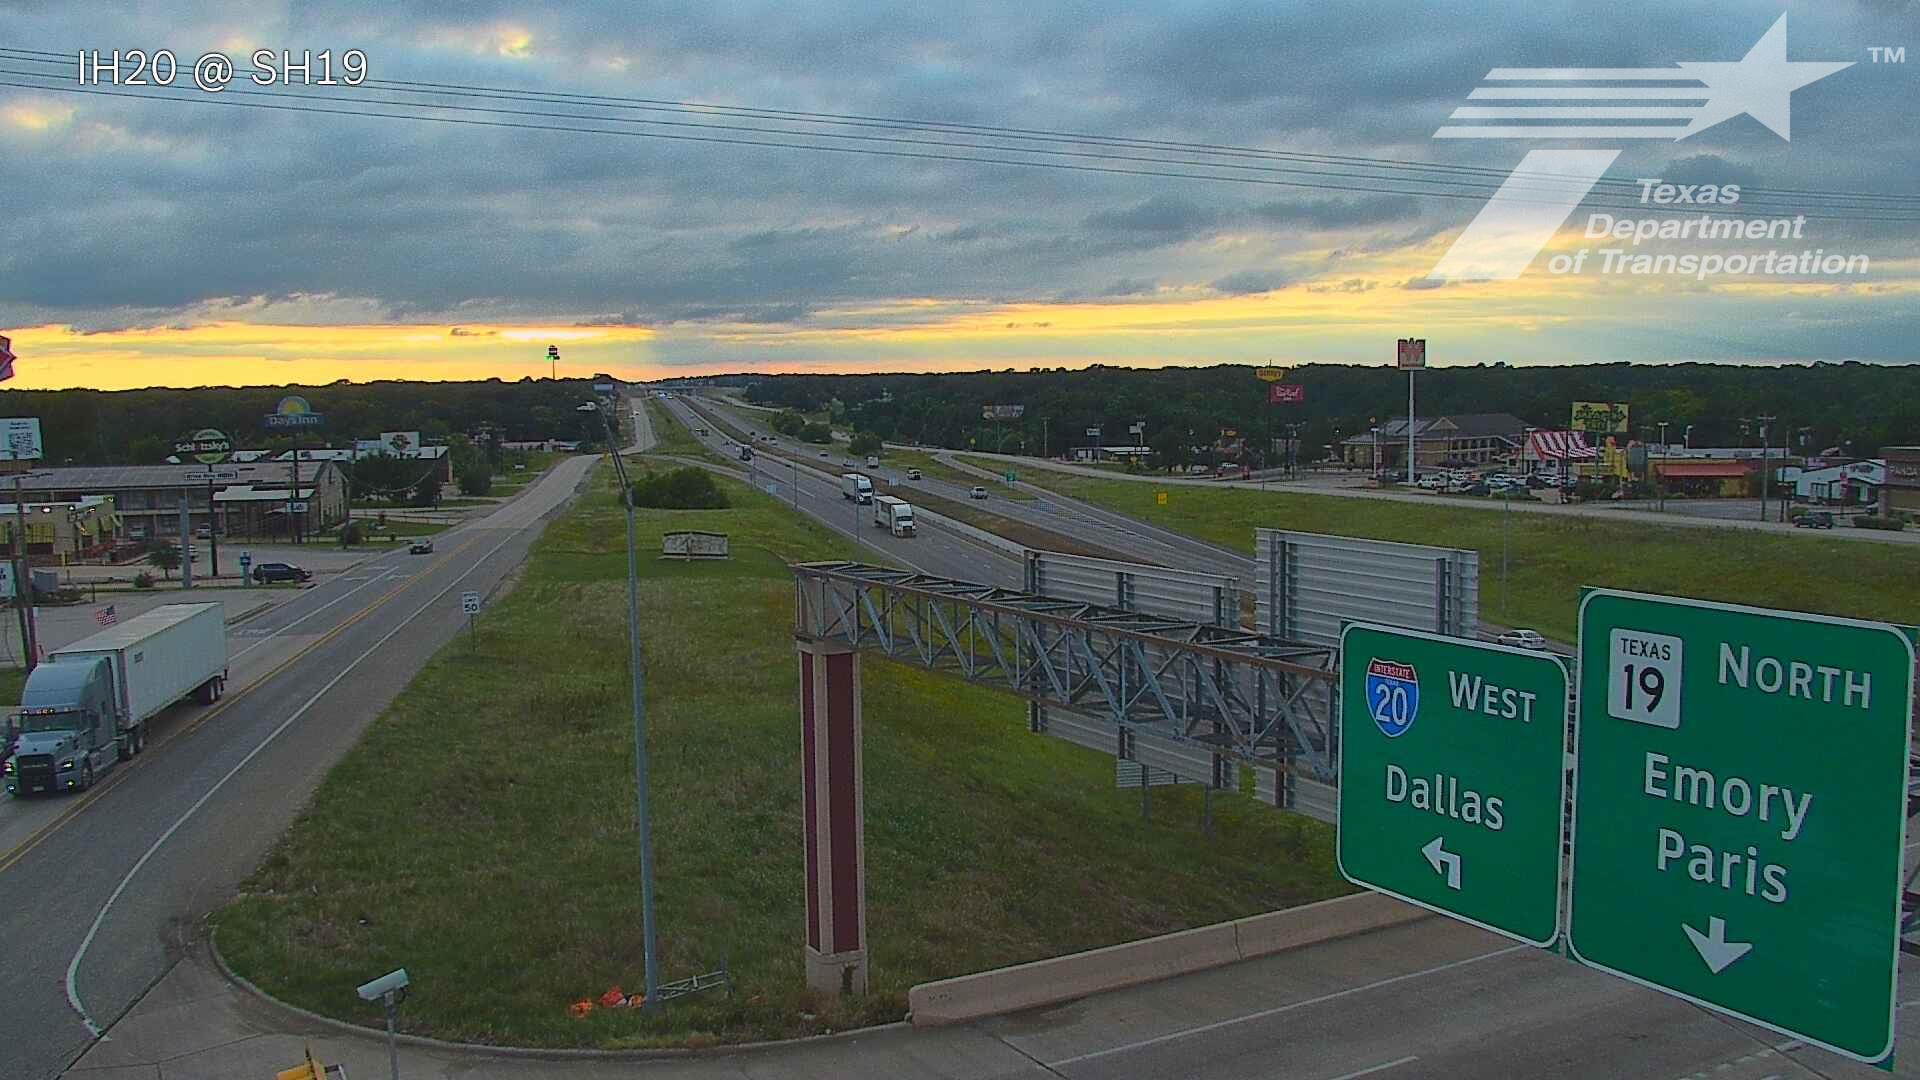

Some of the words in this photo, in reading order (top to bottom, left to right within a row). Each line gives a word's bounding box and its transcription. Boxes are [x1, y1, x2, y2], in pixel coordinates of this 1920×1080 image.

[1373, 663, 1411, 680] INTERSTATE
[1620, 637, 1672, 662] TEXAS
[1449, 671, 1536, 722] WEST
[1623, 663, 1666, 713] 19
[1717, 643, 1872, 710] NORTH
[1375, 683, 1407, 726] 20
[1386, 765, 1504, 831] Dallas
[1644, 752, 1813, 841] Emory
[1657, 828, 1788, 903] Paris
